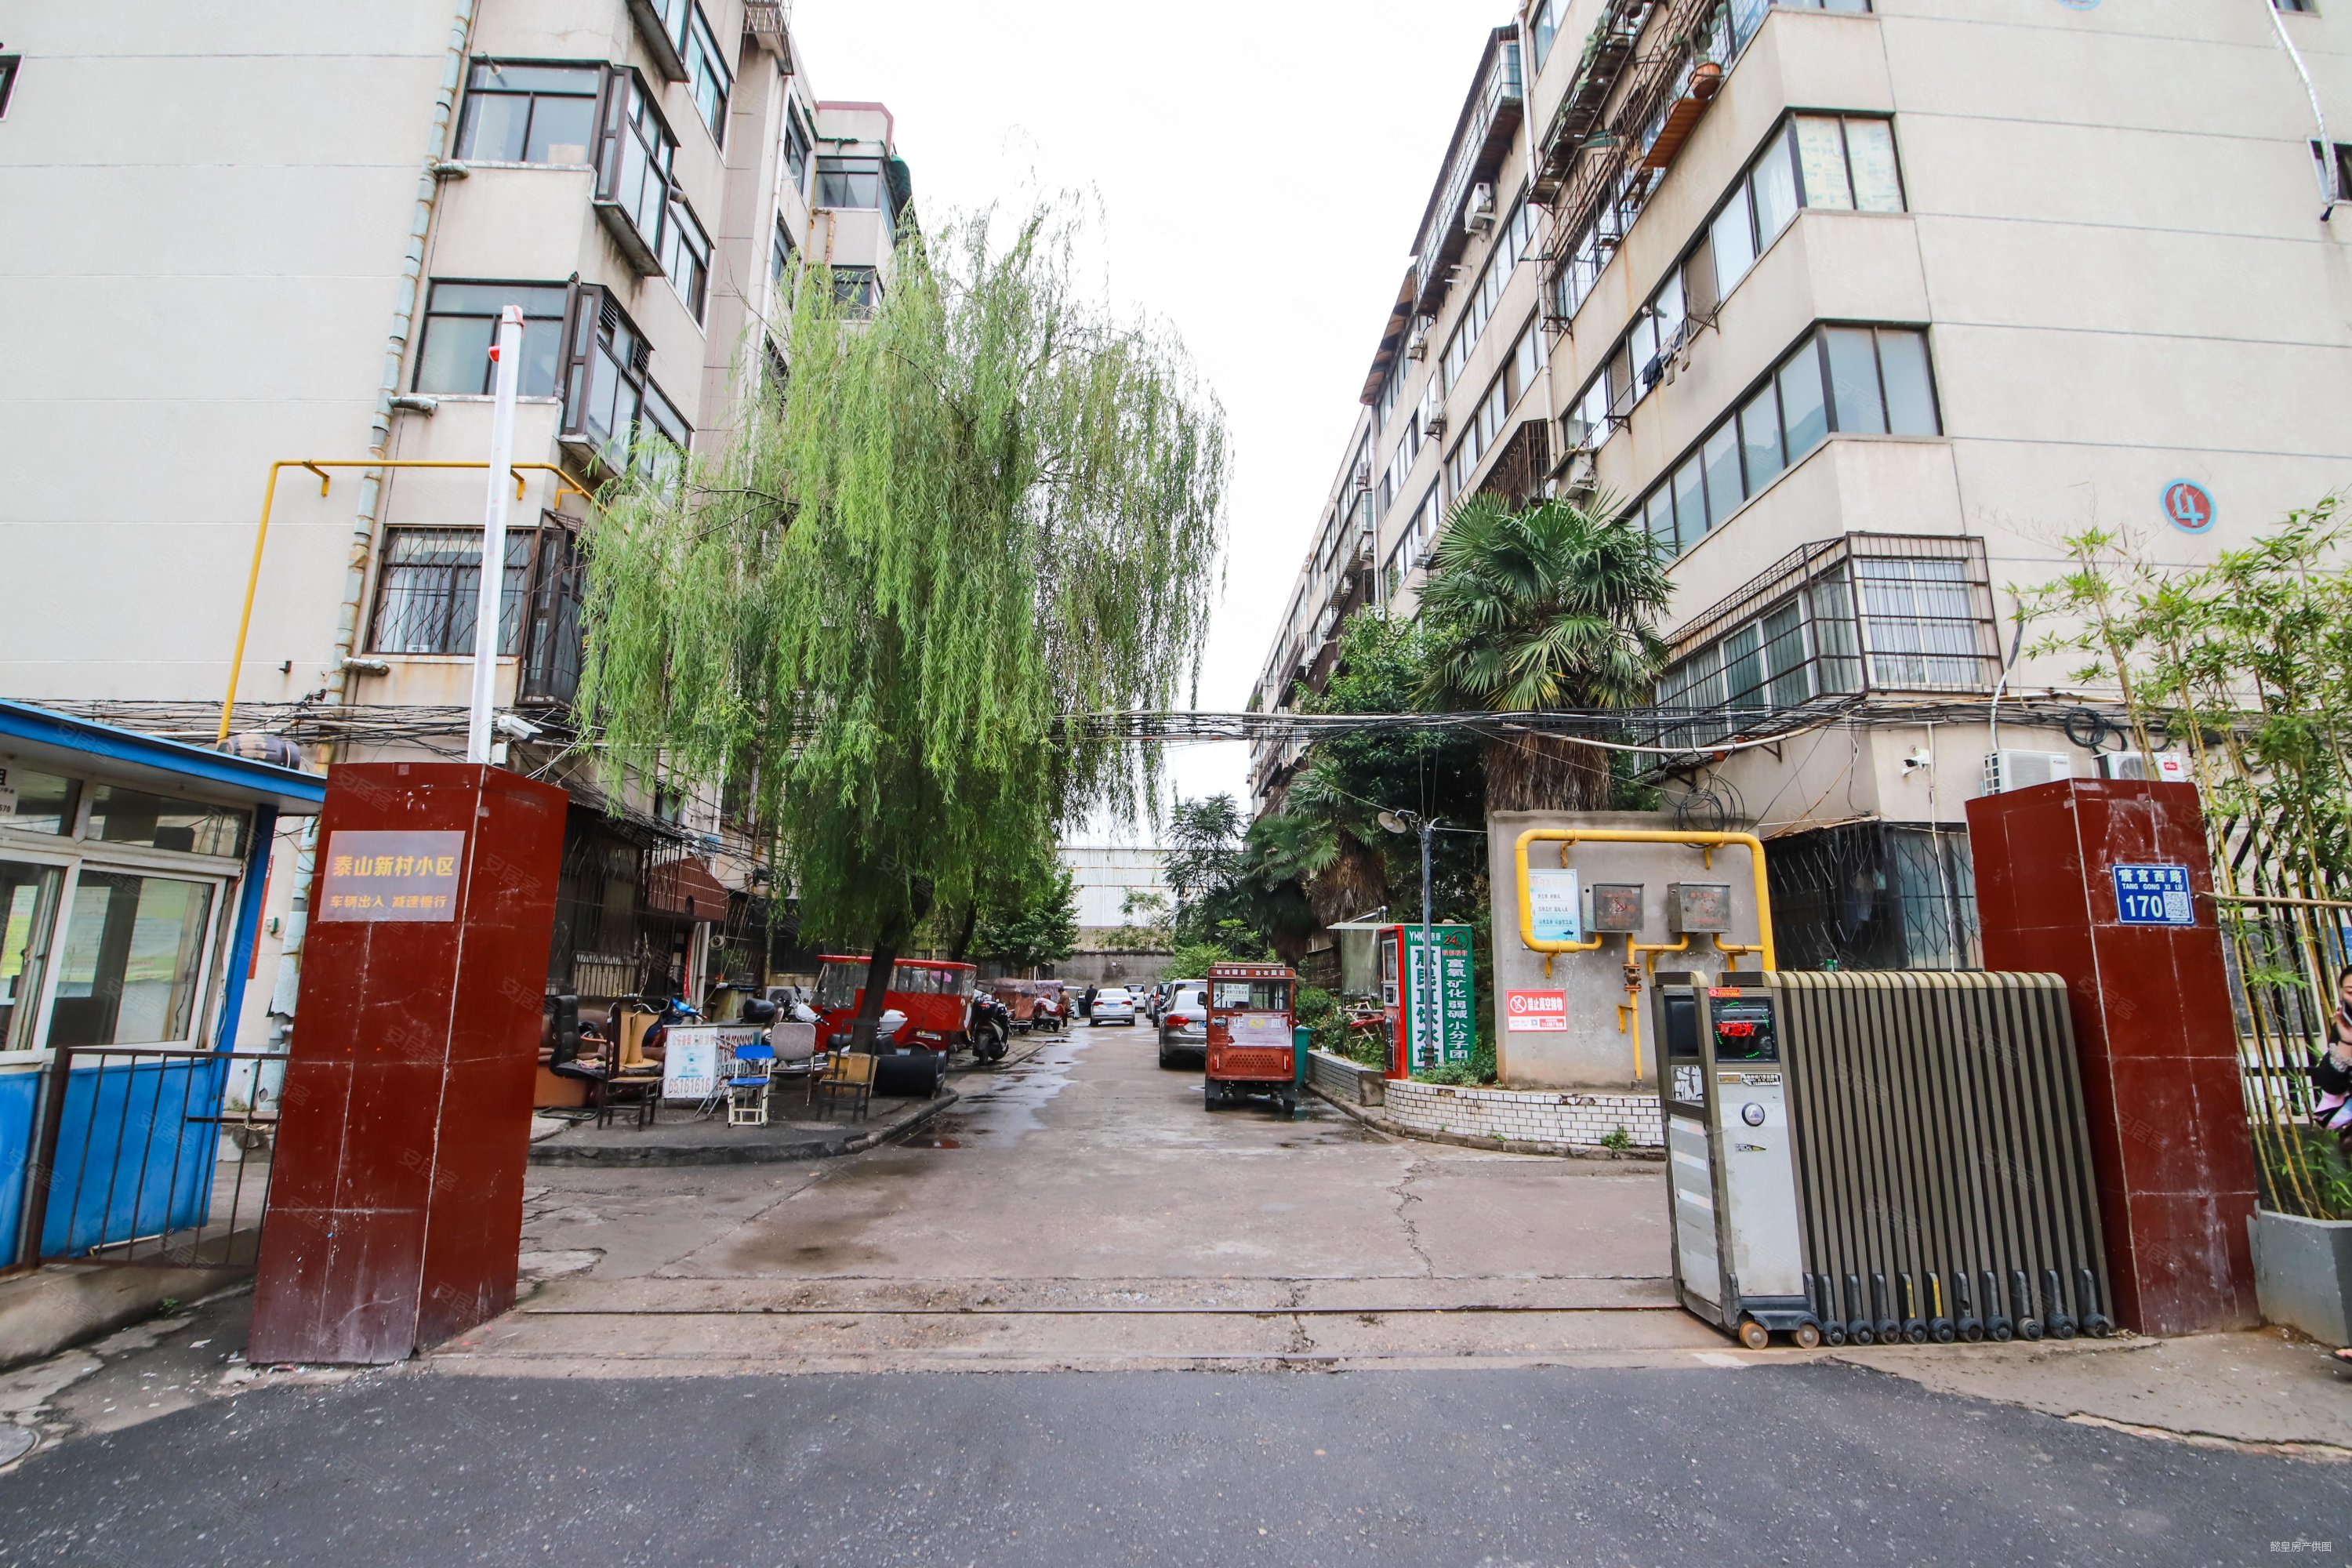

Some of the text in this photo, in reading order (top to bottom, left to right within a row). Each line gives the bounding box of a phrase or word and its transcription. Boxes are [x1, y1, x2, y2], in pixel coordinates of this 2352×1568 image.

[2173, 485, 2204, 526] 4
[332, 855, 455, 877] 泰山新村小区
[2118, 869, 2182, 884] 唐宫西路
[330, 895, 448, 909] 车辆出入 减速慢行
[2125, 895, 2163, 918] 170
[1527, 996, 1563, 1011] 禁止高空抛物
[668, 1077, 711, 1094] 65161616
